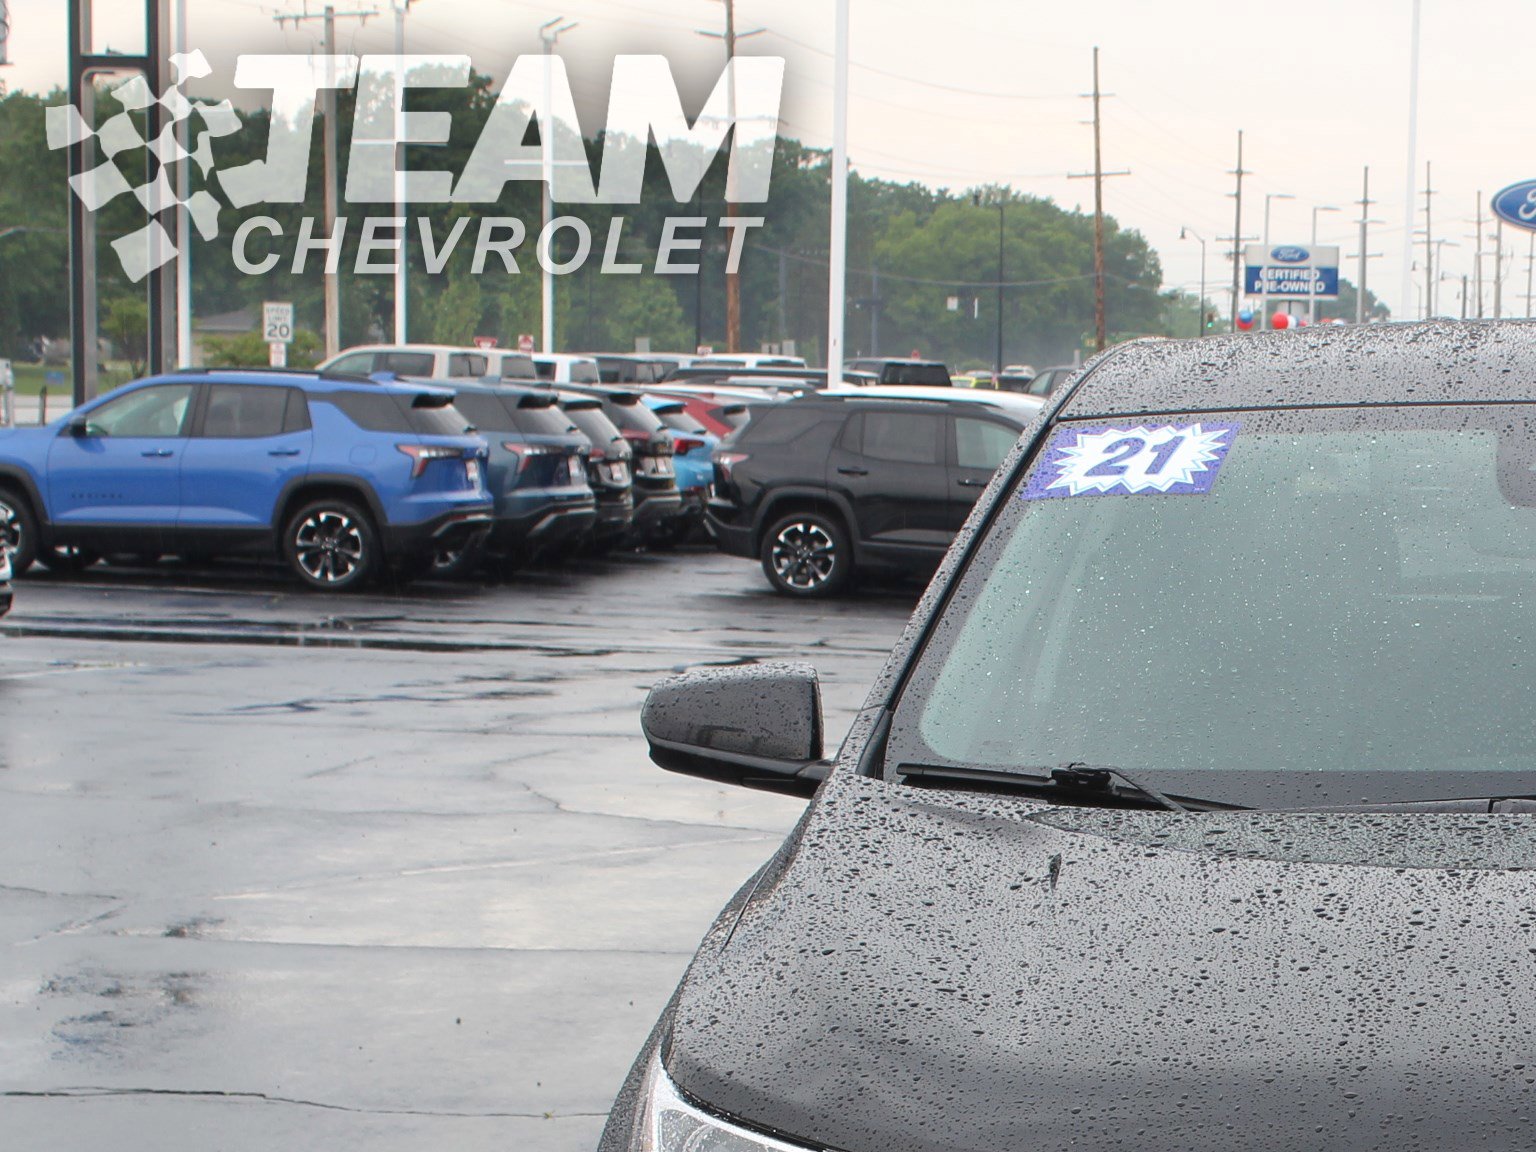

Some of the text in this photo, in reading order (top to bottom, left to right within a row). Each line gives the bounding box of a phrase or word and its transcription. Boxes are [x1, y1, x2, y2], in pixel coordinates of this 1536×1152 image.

[1278, 248, 1300, 260] Ford
[1259, 269, 1320, 281] CERTIFIED
[1254, 281, 1325, 293] PE-OWND
[267, 323, 290, 338] 20
[1084, 435, 1187, 477] 21
